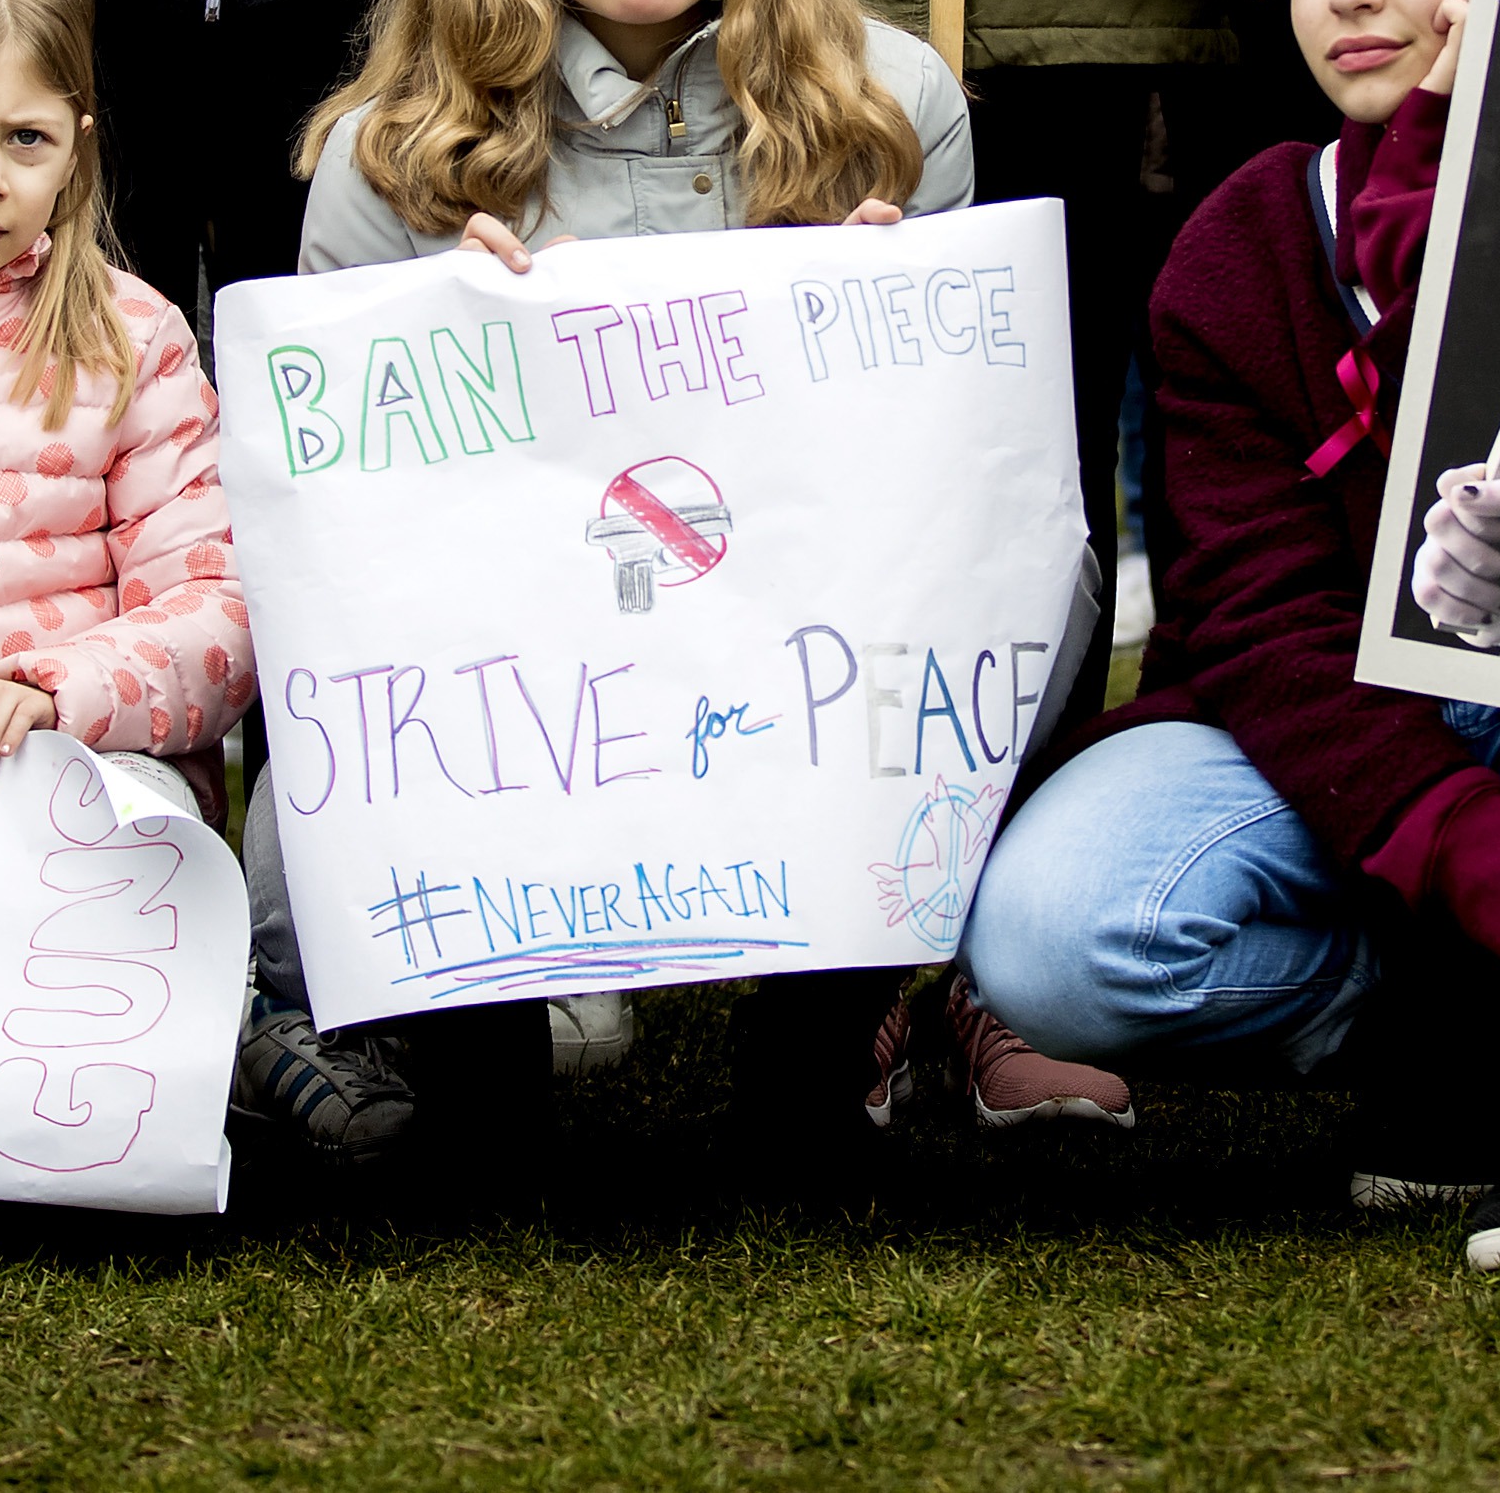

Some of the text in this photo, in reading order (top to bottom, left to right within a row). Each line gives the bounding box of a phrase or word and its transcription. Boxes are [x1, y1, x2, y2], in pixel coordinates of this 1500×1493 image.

[267, 266, 1027, 478] BAN THE PIECE
[284, 624, 1049, 816] STRIVE for PEACE
